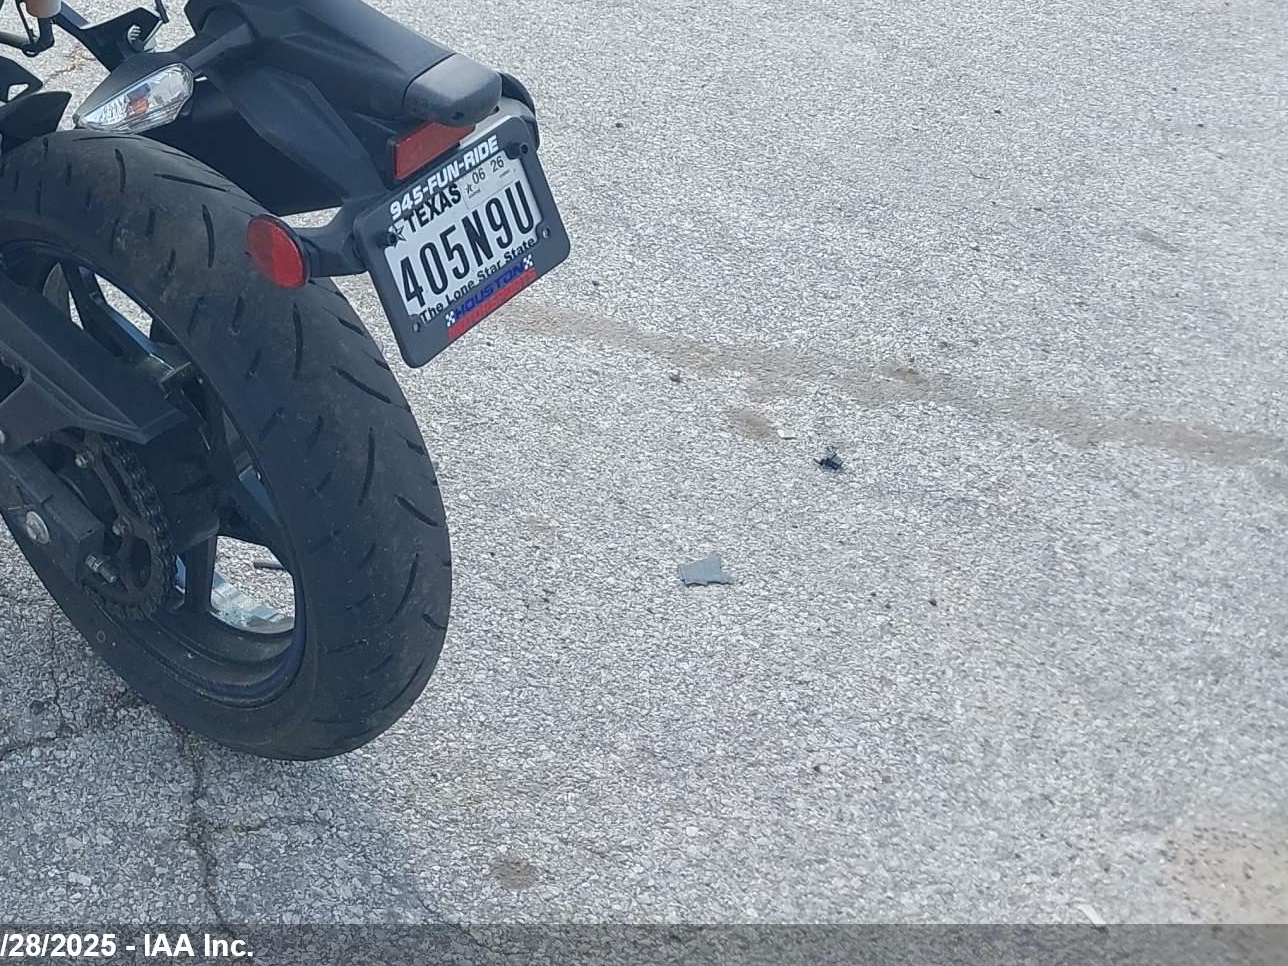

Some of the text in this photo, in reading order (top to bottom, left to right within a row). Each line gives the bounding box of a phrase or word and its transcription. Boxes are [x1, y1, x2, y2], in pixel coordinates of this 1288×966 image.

[389, 134, 499, 220] 945-FUN-RIDE
[403, 183, 462, 233] TEXAS
[472, 168, 486, 184] 06
[490, 156, 505, 172] 26
[400, 180, 534, 308] 405N9U
[419, 237, 536, 324] The Lone Star State
[454, 261, 525, 320] HOUSTON
